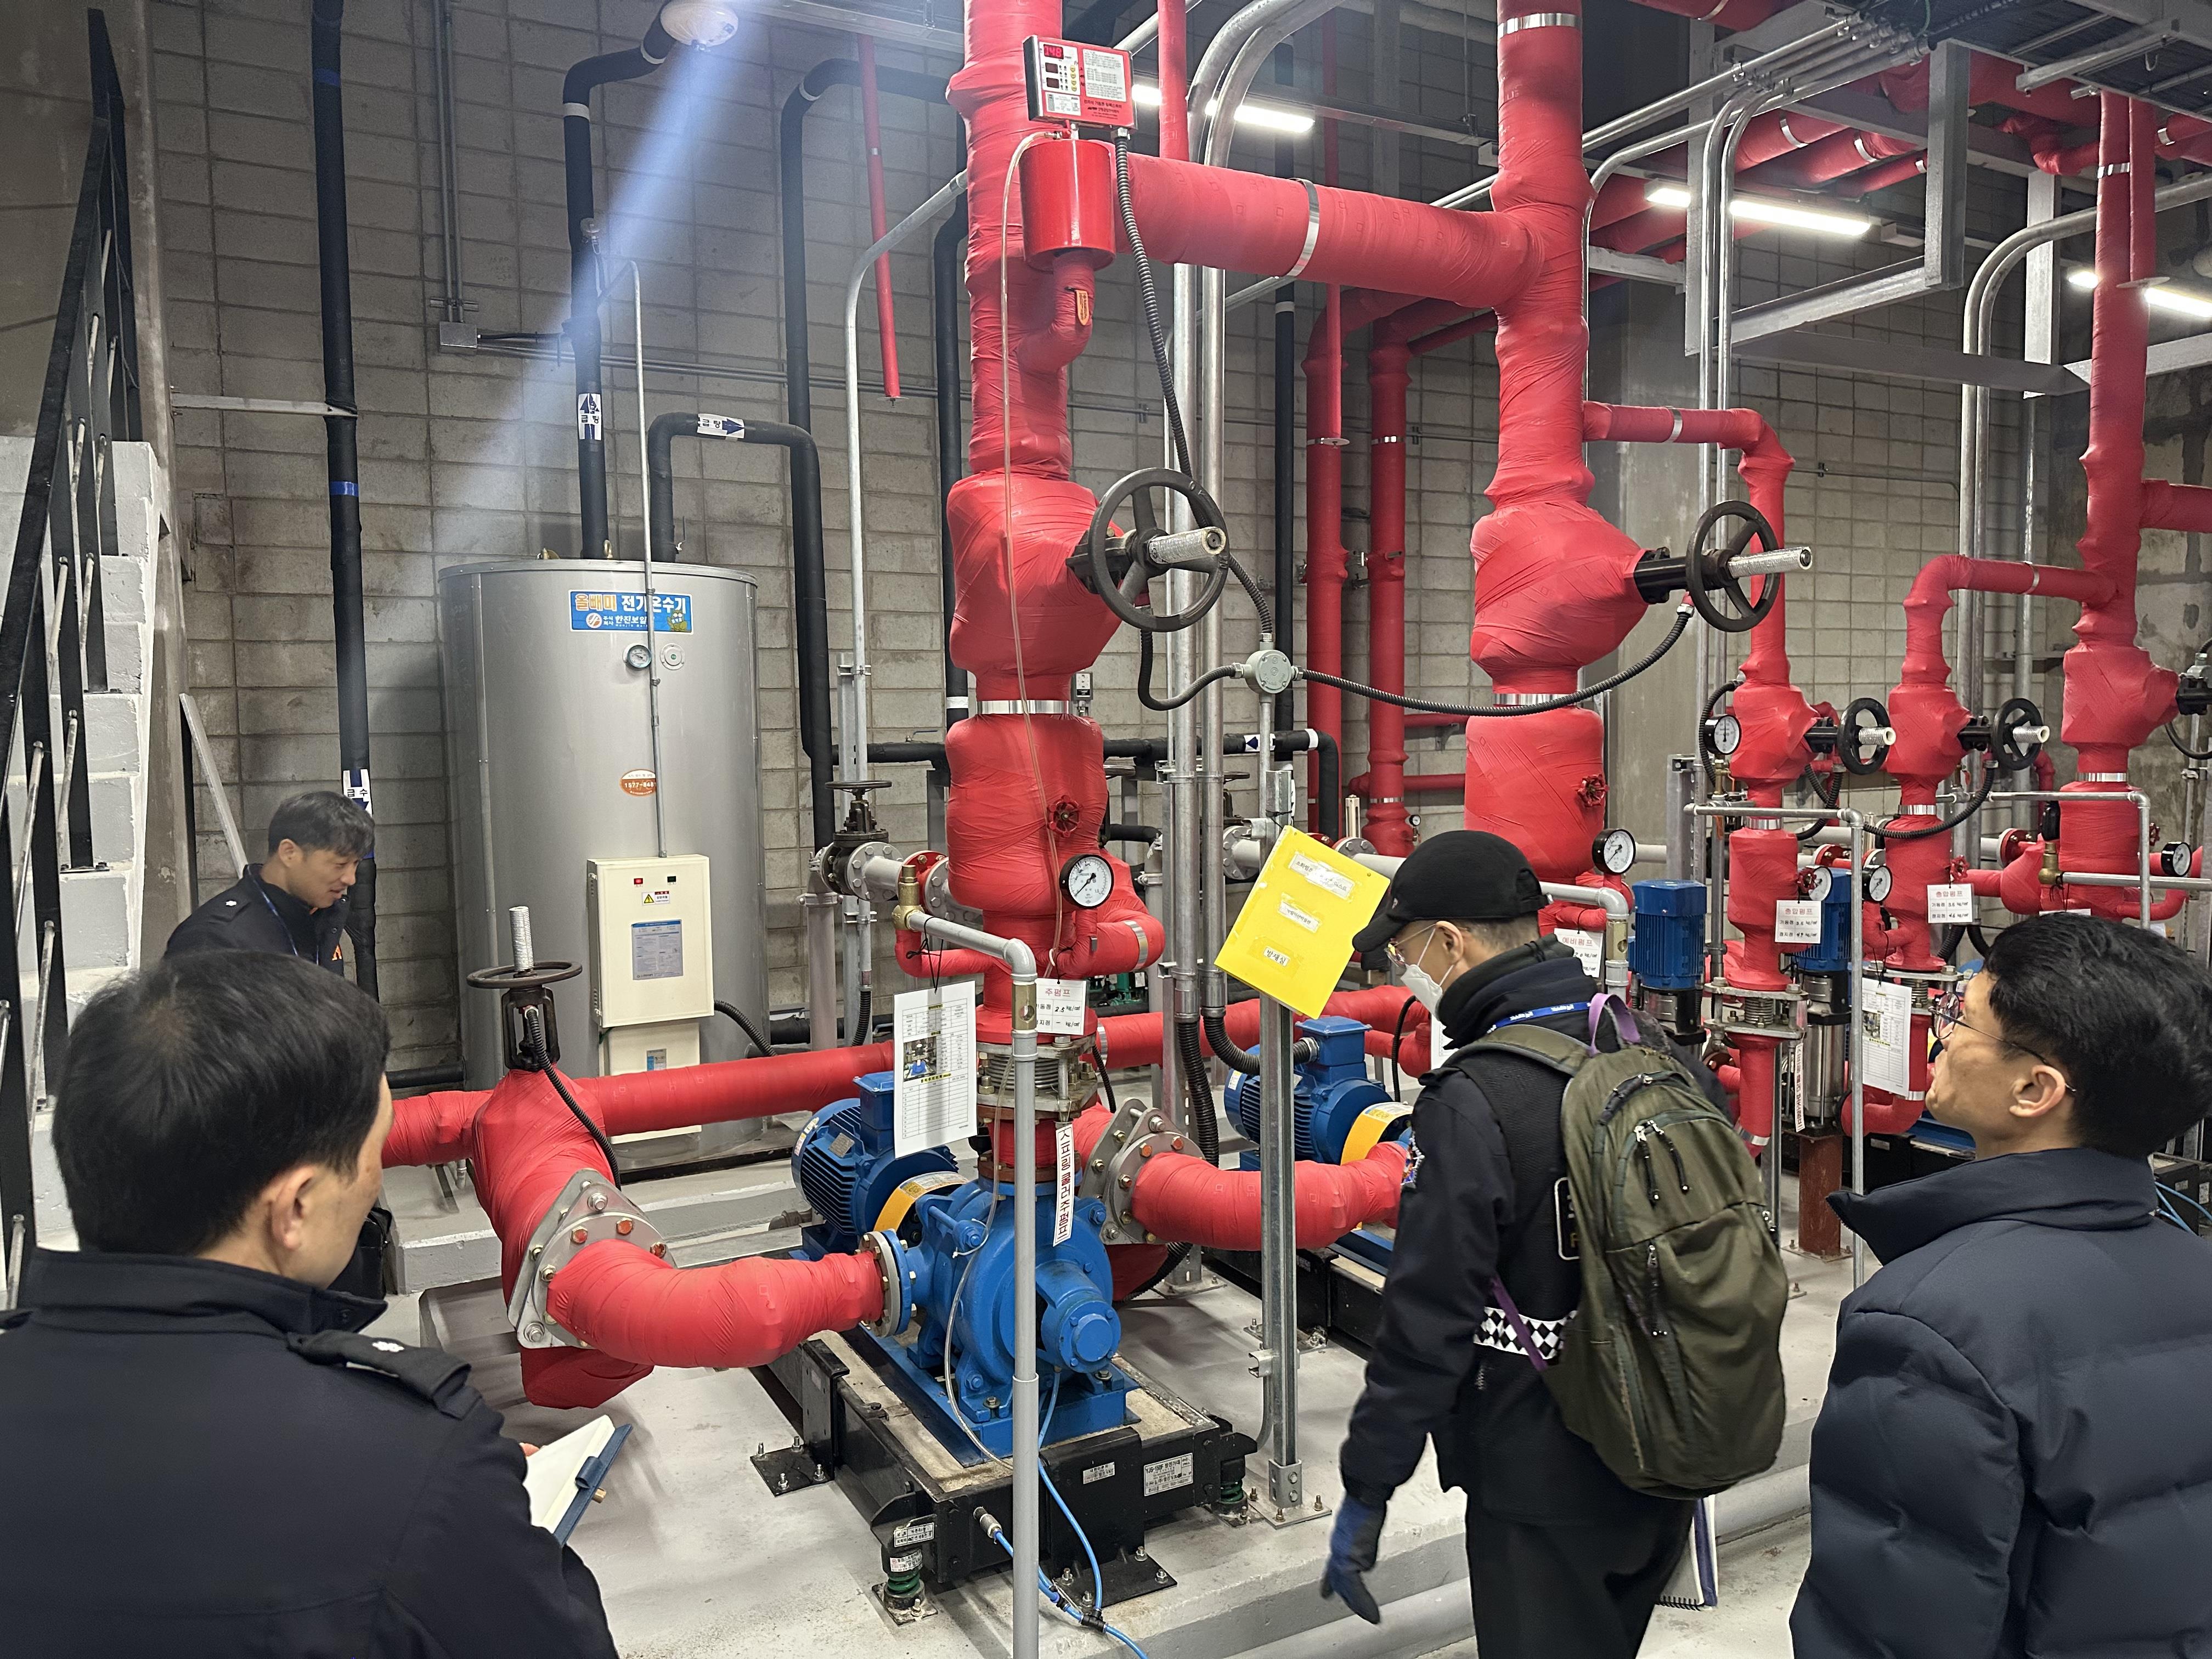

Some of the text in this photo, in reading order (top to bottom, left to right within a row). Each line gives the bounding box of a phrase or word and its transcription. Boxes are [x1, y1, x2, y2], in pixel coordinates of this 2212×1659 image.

[575, 594, 617, 612] 올빼미
[1562, 937, 1593, 946] 예비펌프
[1045, 988, 1070, 997] 주펌프
